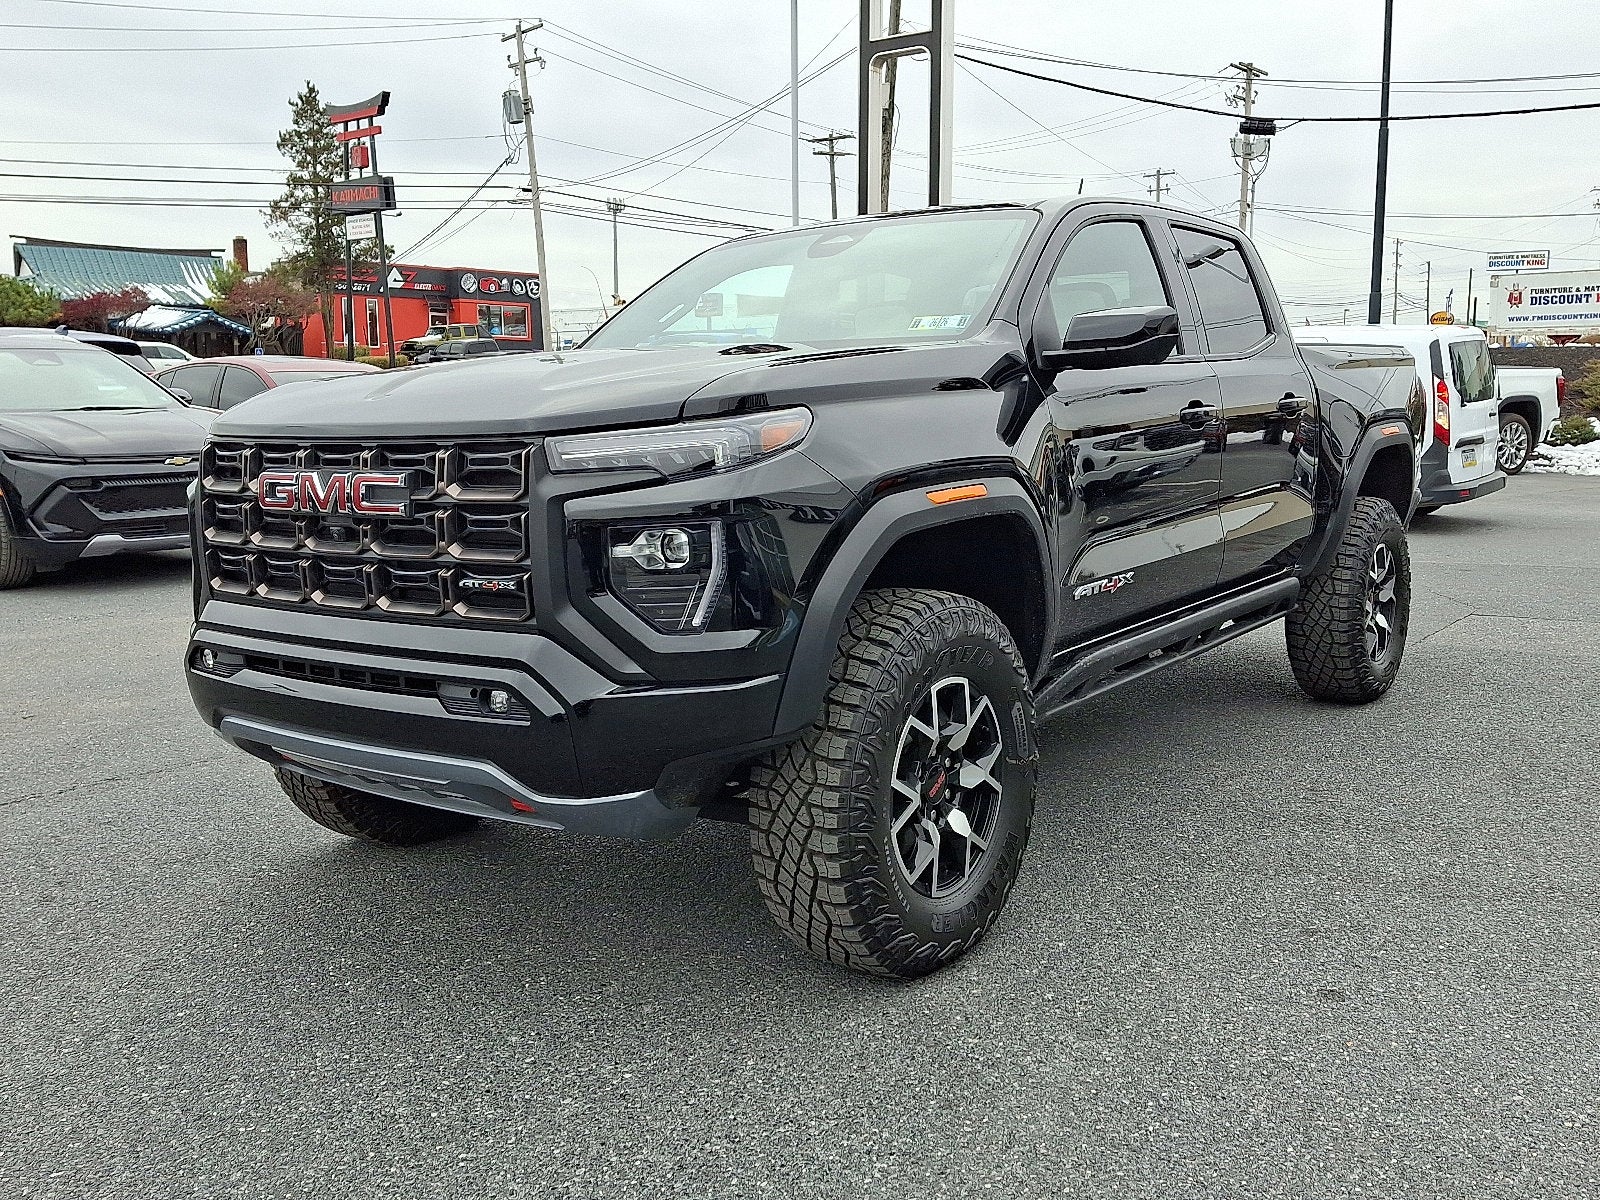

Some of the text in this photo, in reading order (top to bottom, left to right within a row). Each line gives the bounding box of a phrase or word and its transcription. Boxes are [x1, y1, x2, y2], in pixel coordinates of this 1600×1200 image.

[1489, 258, 1546, 268] DISCOUNT KING
[1530, 286, 1574, 295] FURNITURE
[1530, 293, 1593, 306] DISCOUNT
[258, 471, 411, 518] GMC
[458, 579, 517, 592] AT4X
[1072, 571, 1135, 601] AT4X
